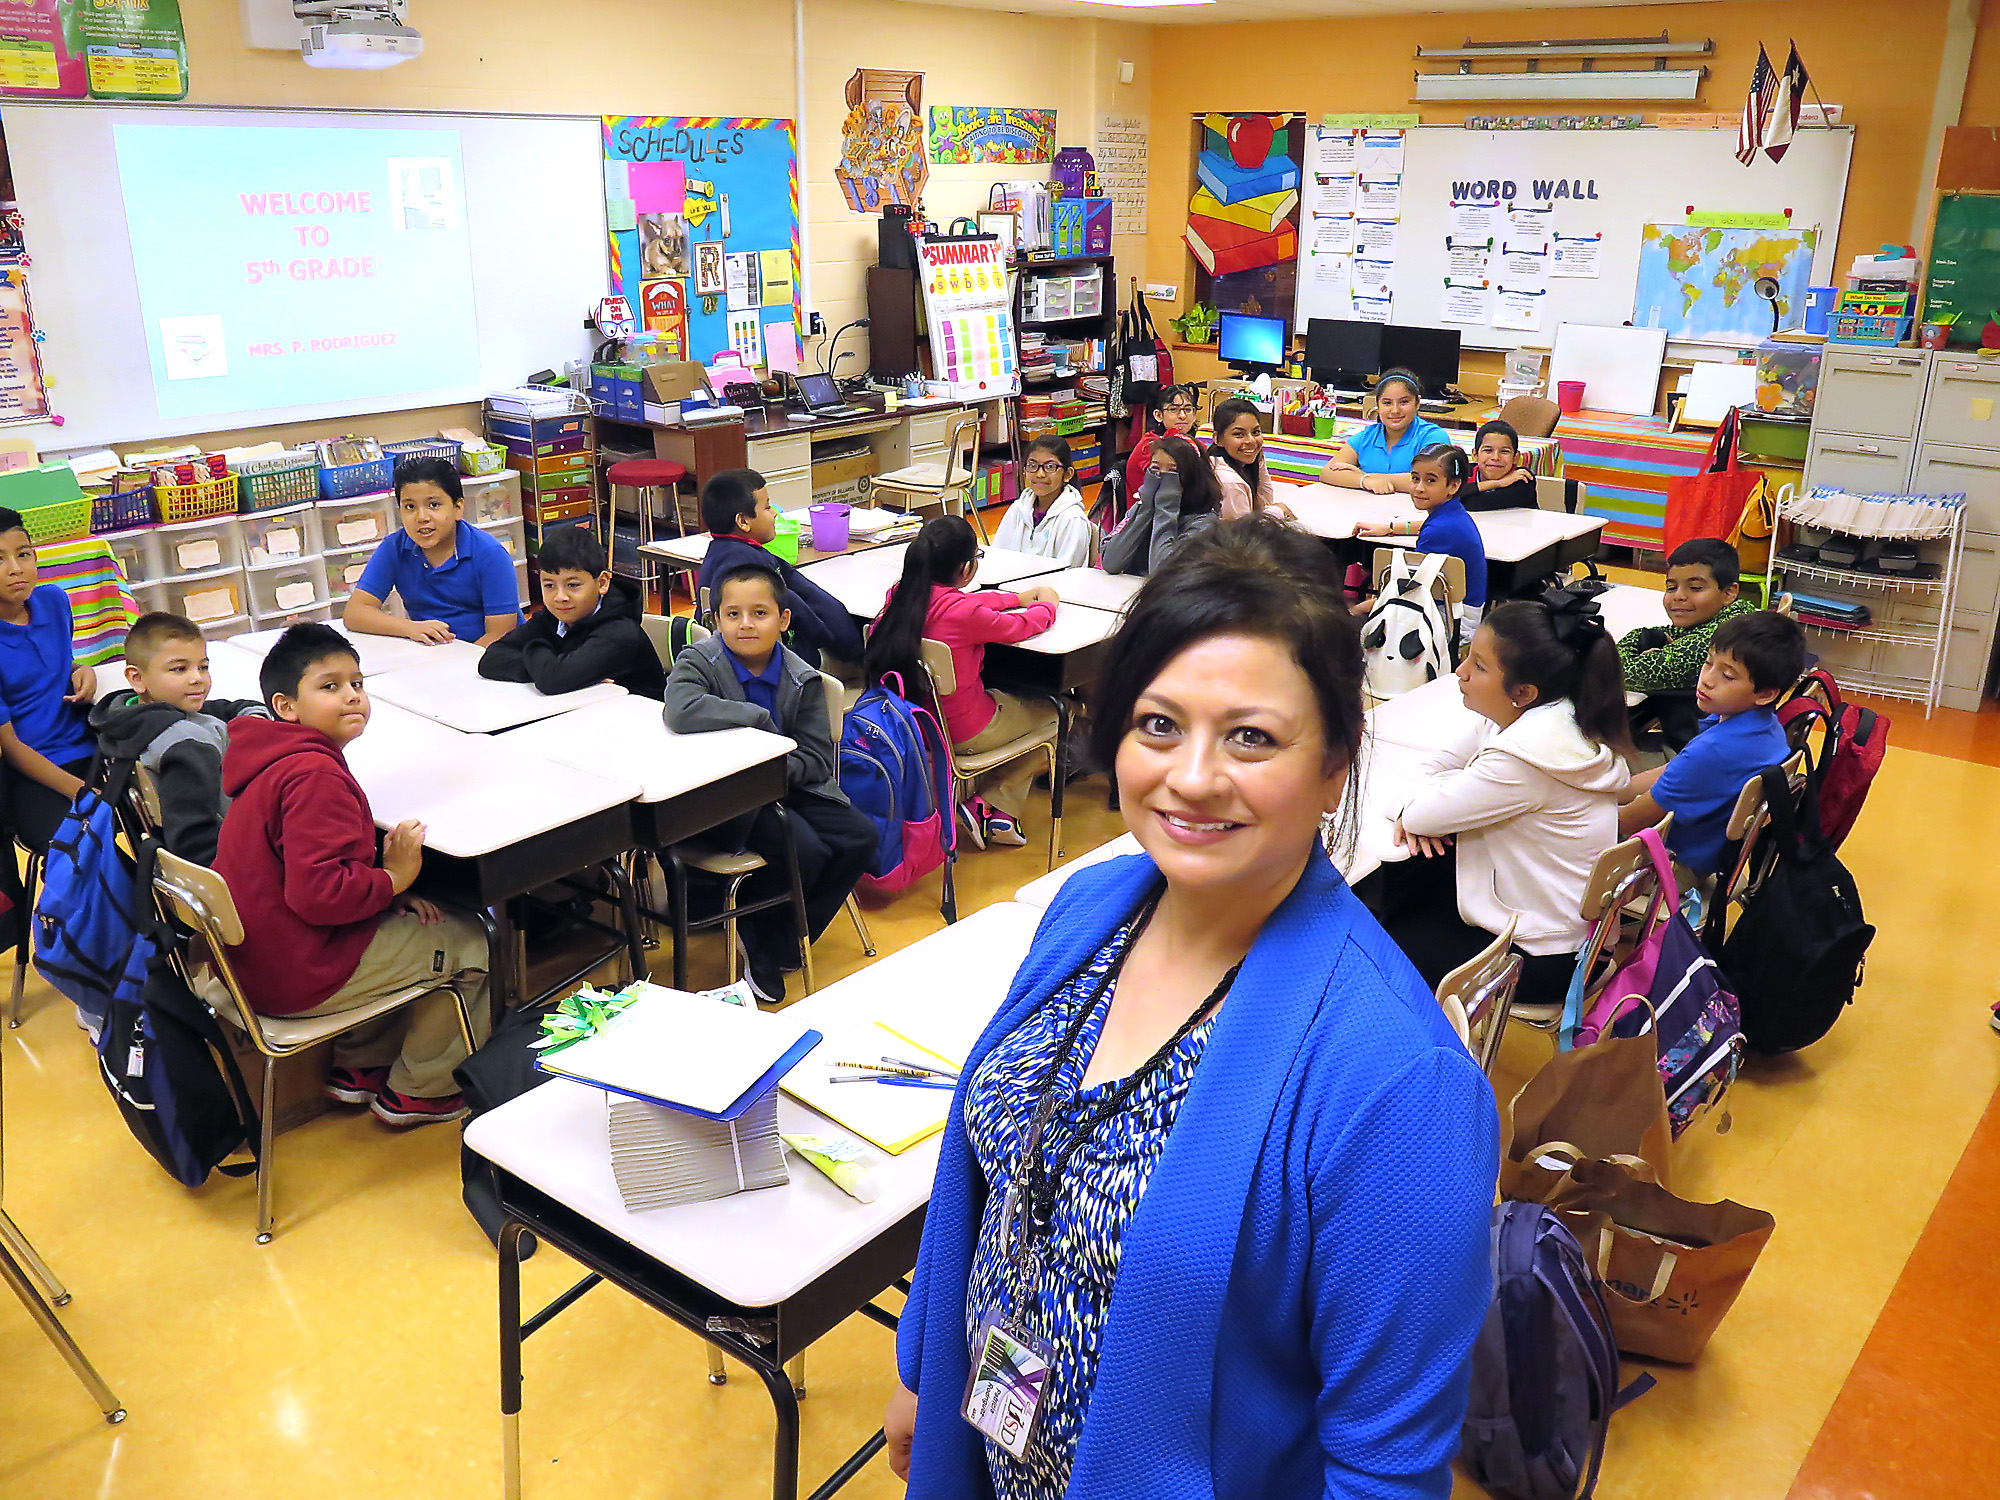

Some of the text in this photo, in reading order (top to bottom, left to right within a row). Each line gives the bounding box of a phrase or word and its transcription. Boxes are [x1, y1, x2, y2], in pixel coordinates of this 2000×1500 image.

[957, 109, 1042, 140] Books are Treasures
[963, 128, 988, 146] WAITING
[1005, 126, 1037, 146] DISCOVERED
[618, 129, 744, 162] SCHEDULES
[1452, 179, 1599, 200] WORD WALL
[239, 192, 371, 216] WELCOME
[292, 225, 330, 247] TO
[929, 244, 1000, 266] SUMMARY
[245, 259, 280, 284] 5th
[651, 301, 676, 311] WHAT
[980, 1381, 994, 1418] Rodriguez
